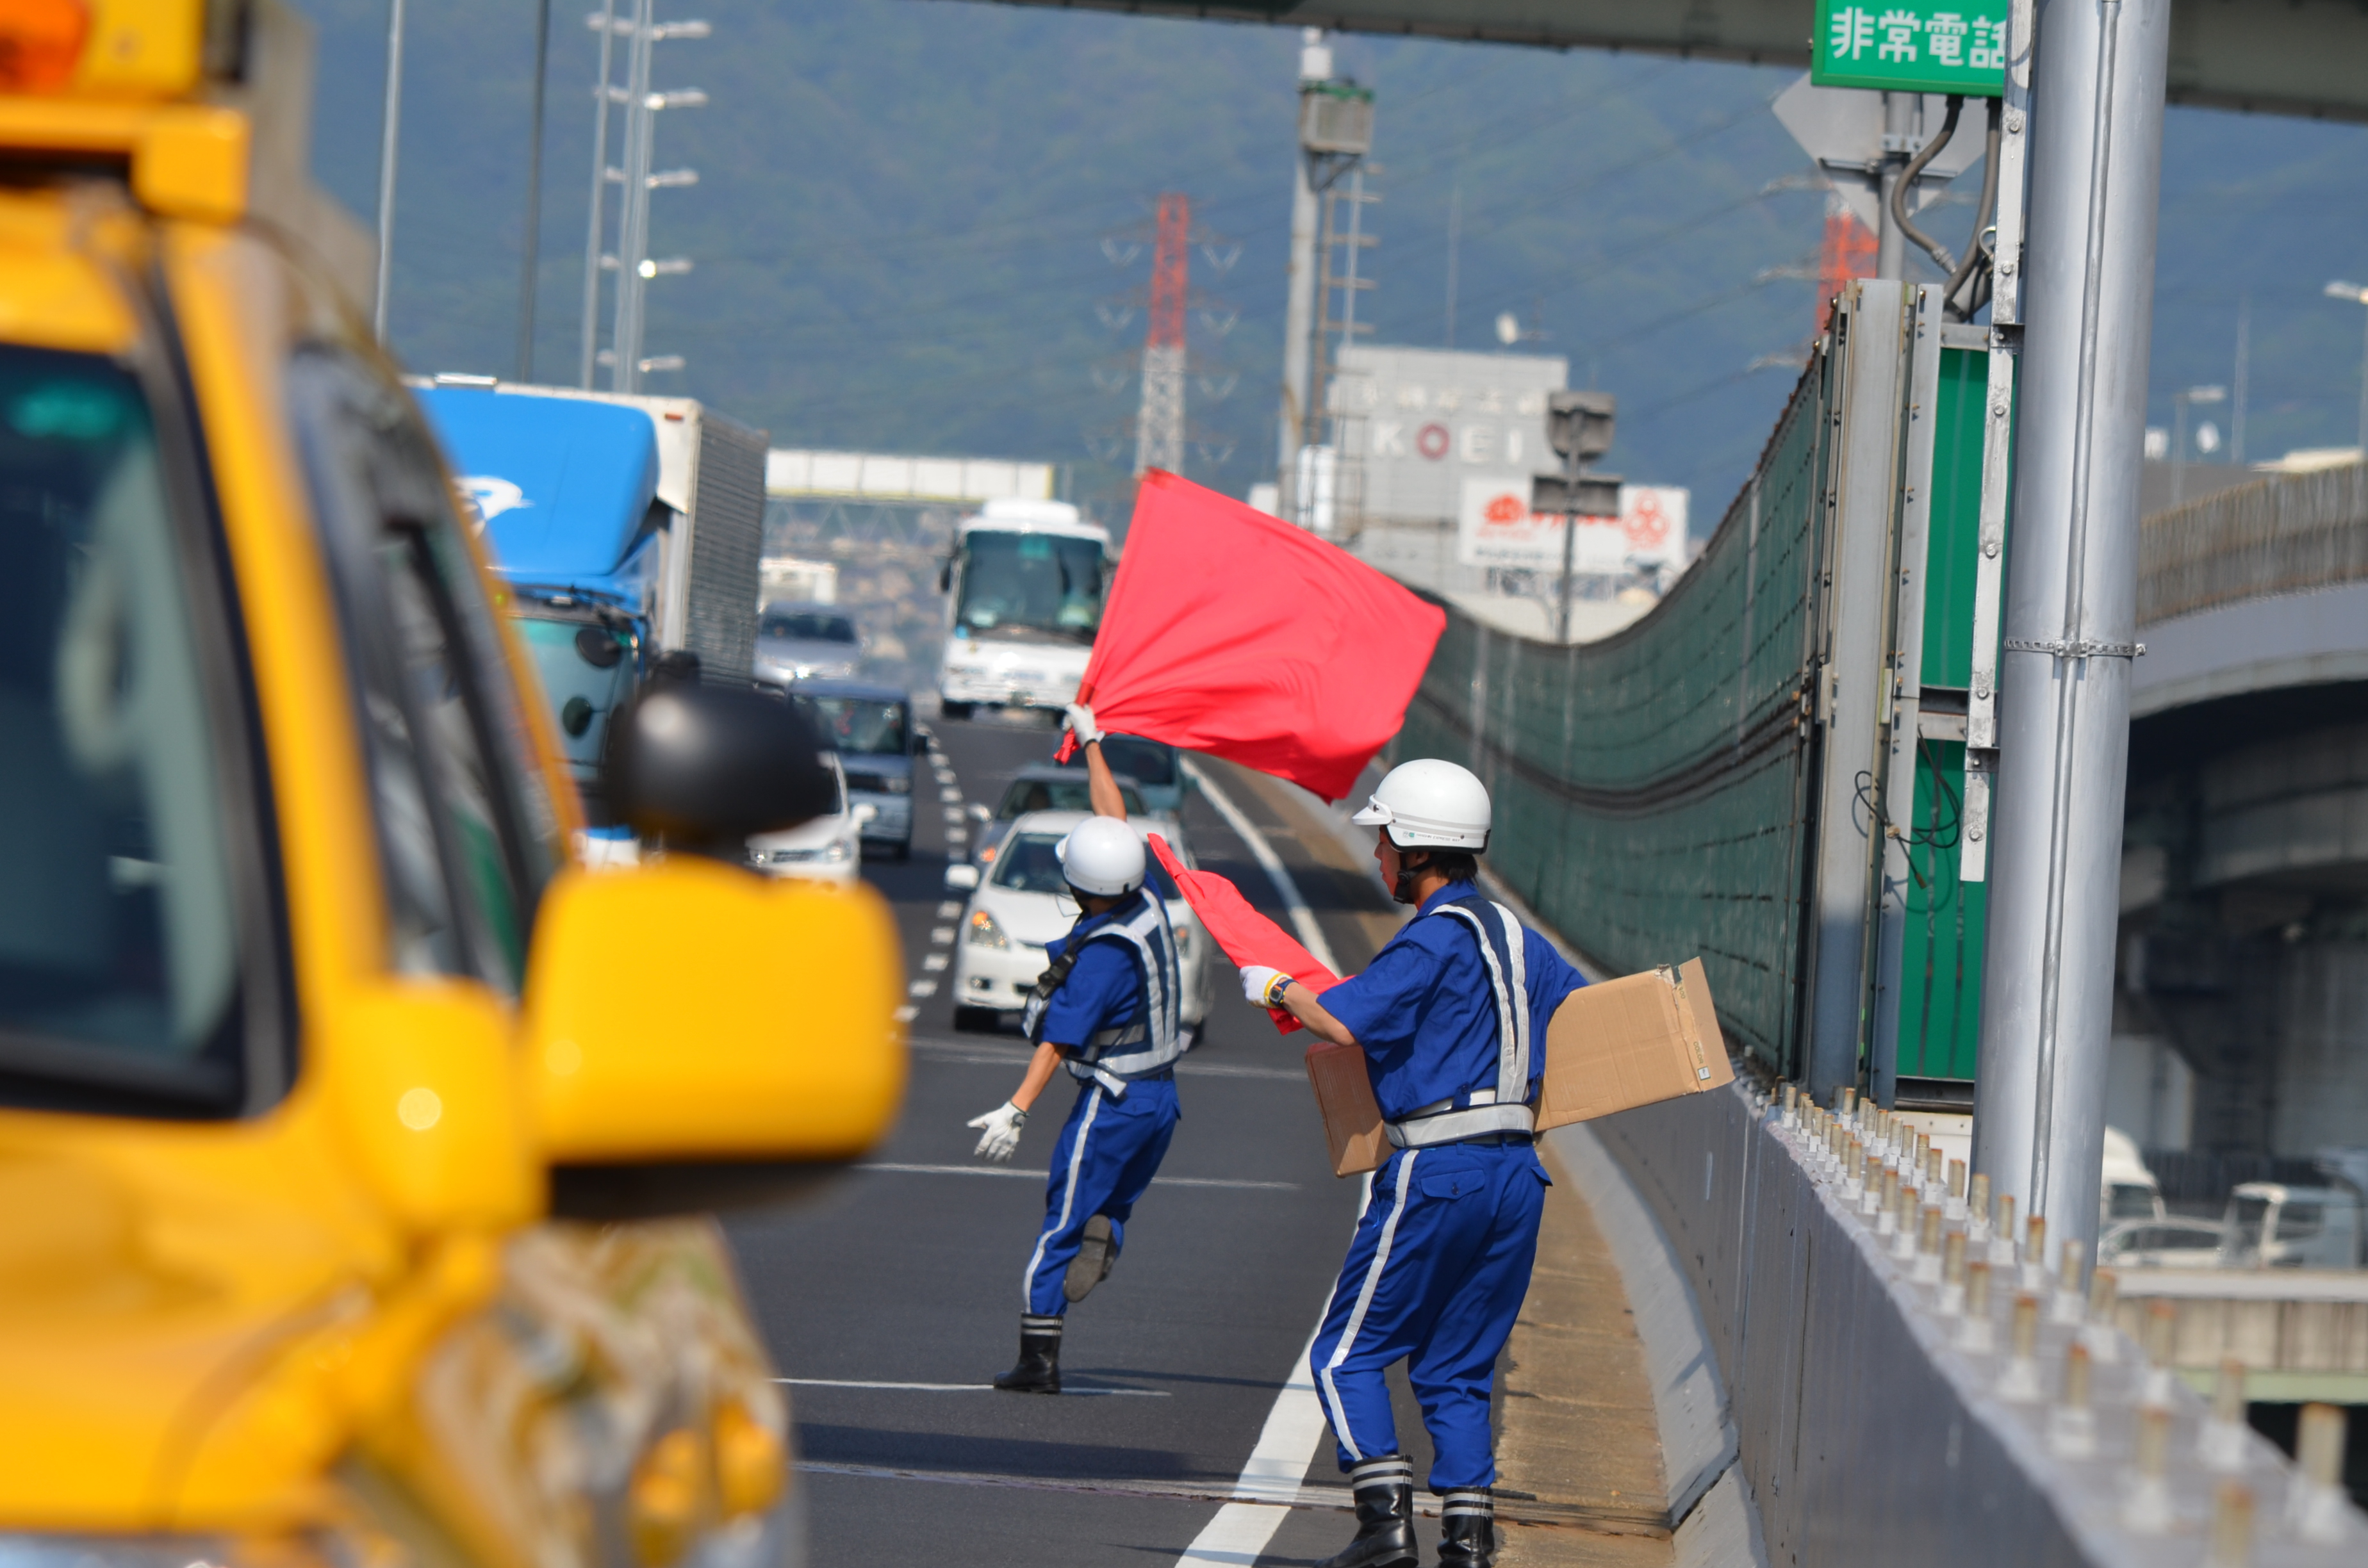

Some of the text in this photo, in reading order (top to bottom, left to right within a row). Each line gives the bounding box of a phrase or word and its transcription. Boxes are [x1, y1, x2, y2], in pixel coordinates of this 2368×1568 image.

[1830, 6, 2005, 69] 非常電話
[1375, 422, 1522, 464] KOEI
[1693, 1041, 1704, 1064] COLOR
